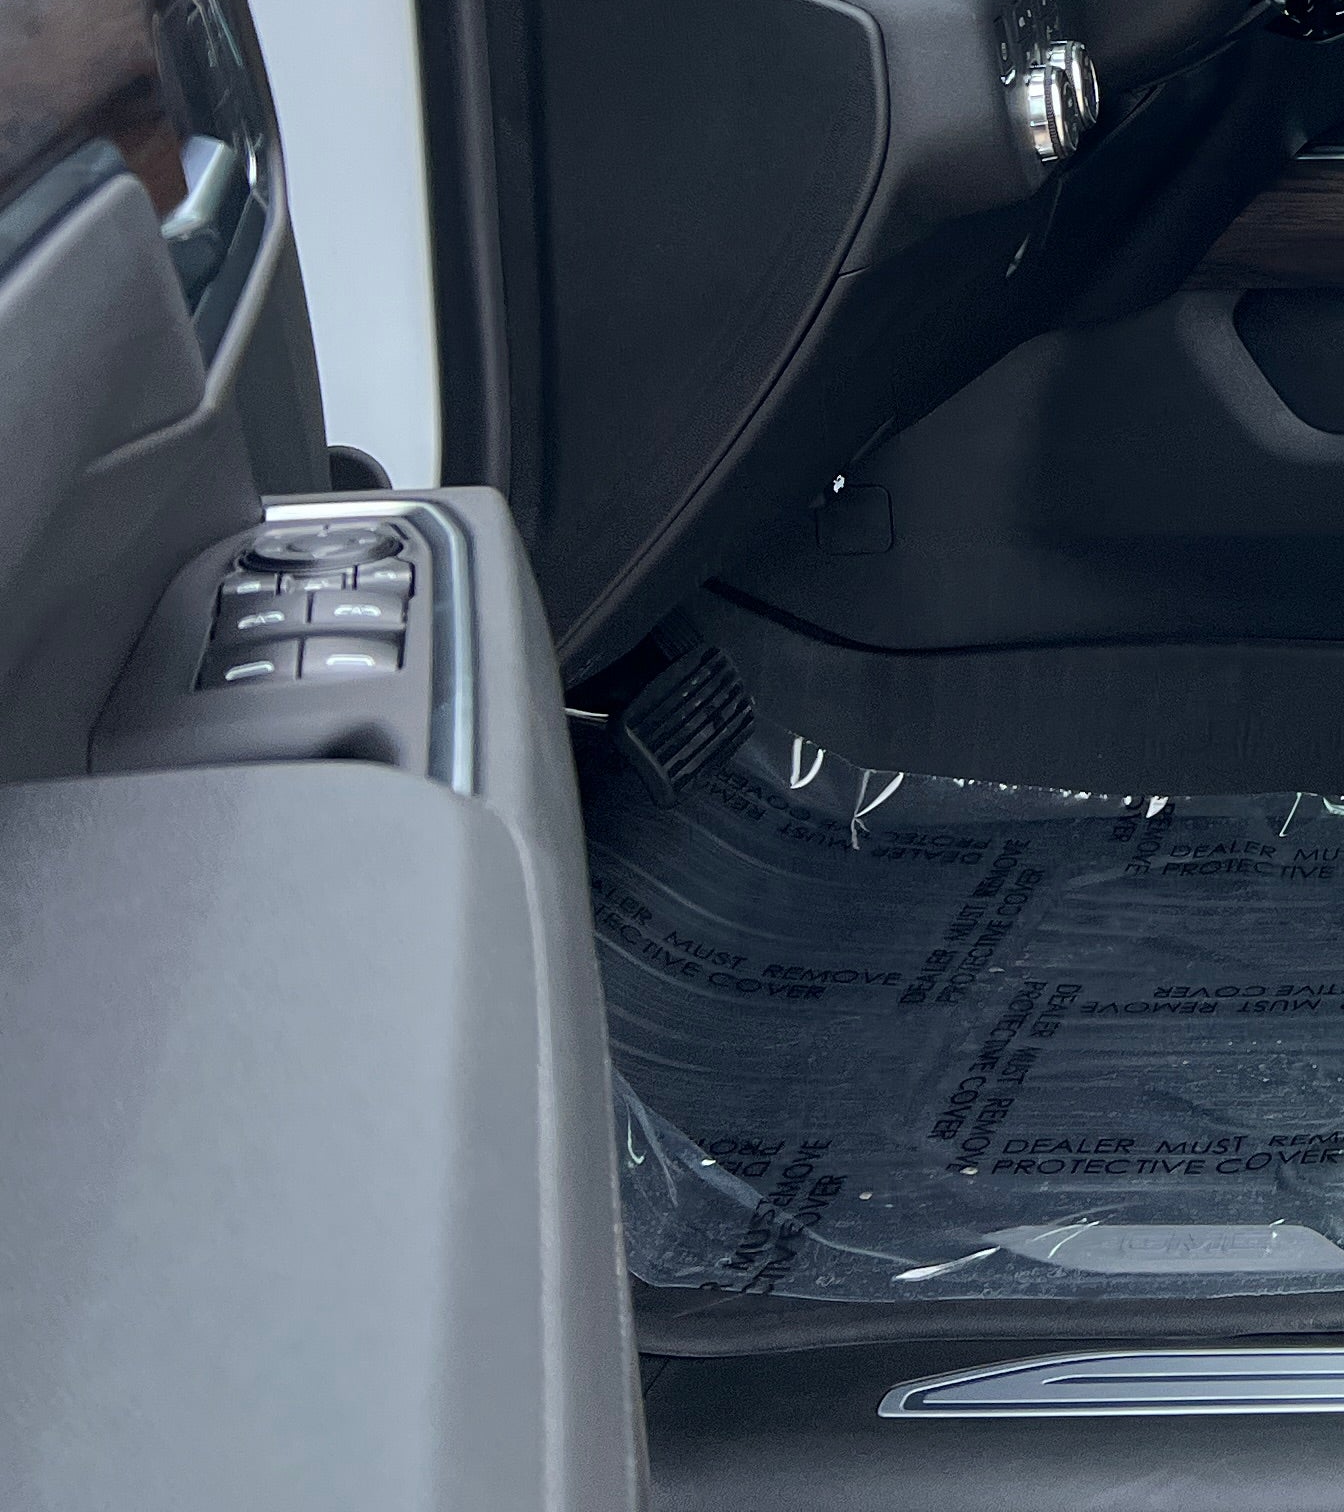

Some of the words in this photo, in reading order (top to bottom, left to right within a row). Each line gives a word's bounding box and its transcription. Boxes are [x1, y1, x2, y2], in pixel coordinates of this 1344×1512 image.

[1170, 840, 1277, 860] DEALER
[1161, 859, 1335, 880] PROTECTIVE
[594, 904, 703, 978] TECTIVE
[709, 971, 827, 1000] COVER
[664, 931, 749, 971] MUST
[762, 964, 902, 987] REMOVE
[1152, 986, 1267, 1000] COVER
[1079, 1000, 1217, 1015] REMOVE
[1236, 998, 1323, 1014] MUST
[928, 1076, 987, 1140] COVER
[1003, 1137, 1136, 1155] DEALER
[1156, 1135, 1245, 1156] MUST
[990, 1157, 1206, 1176] PROTECTIVE
[1216, 1148, 1342, 1176] COVER
